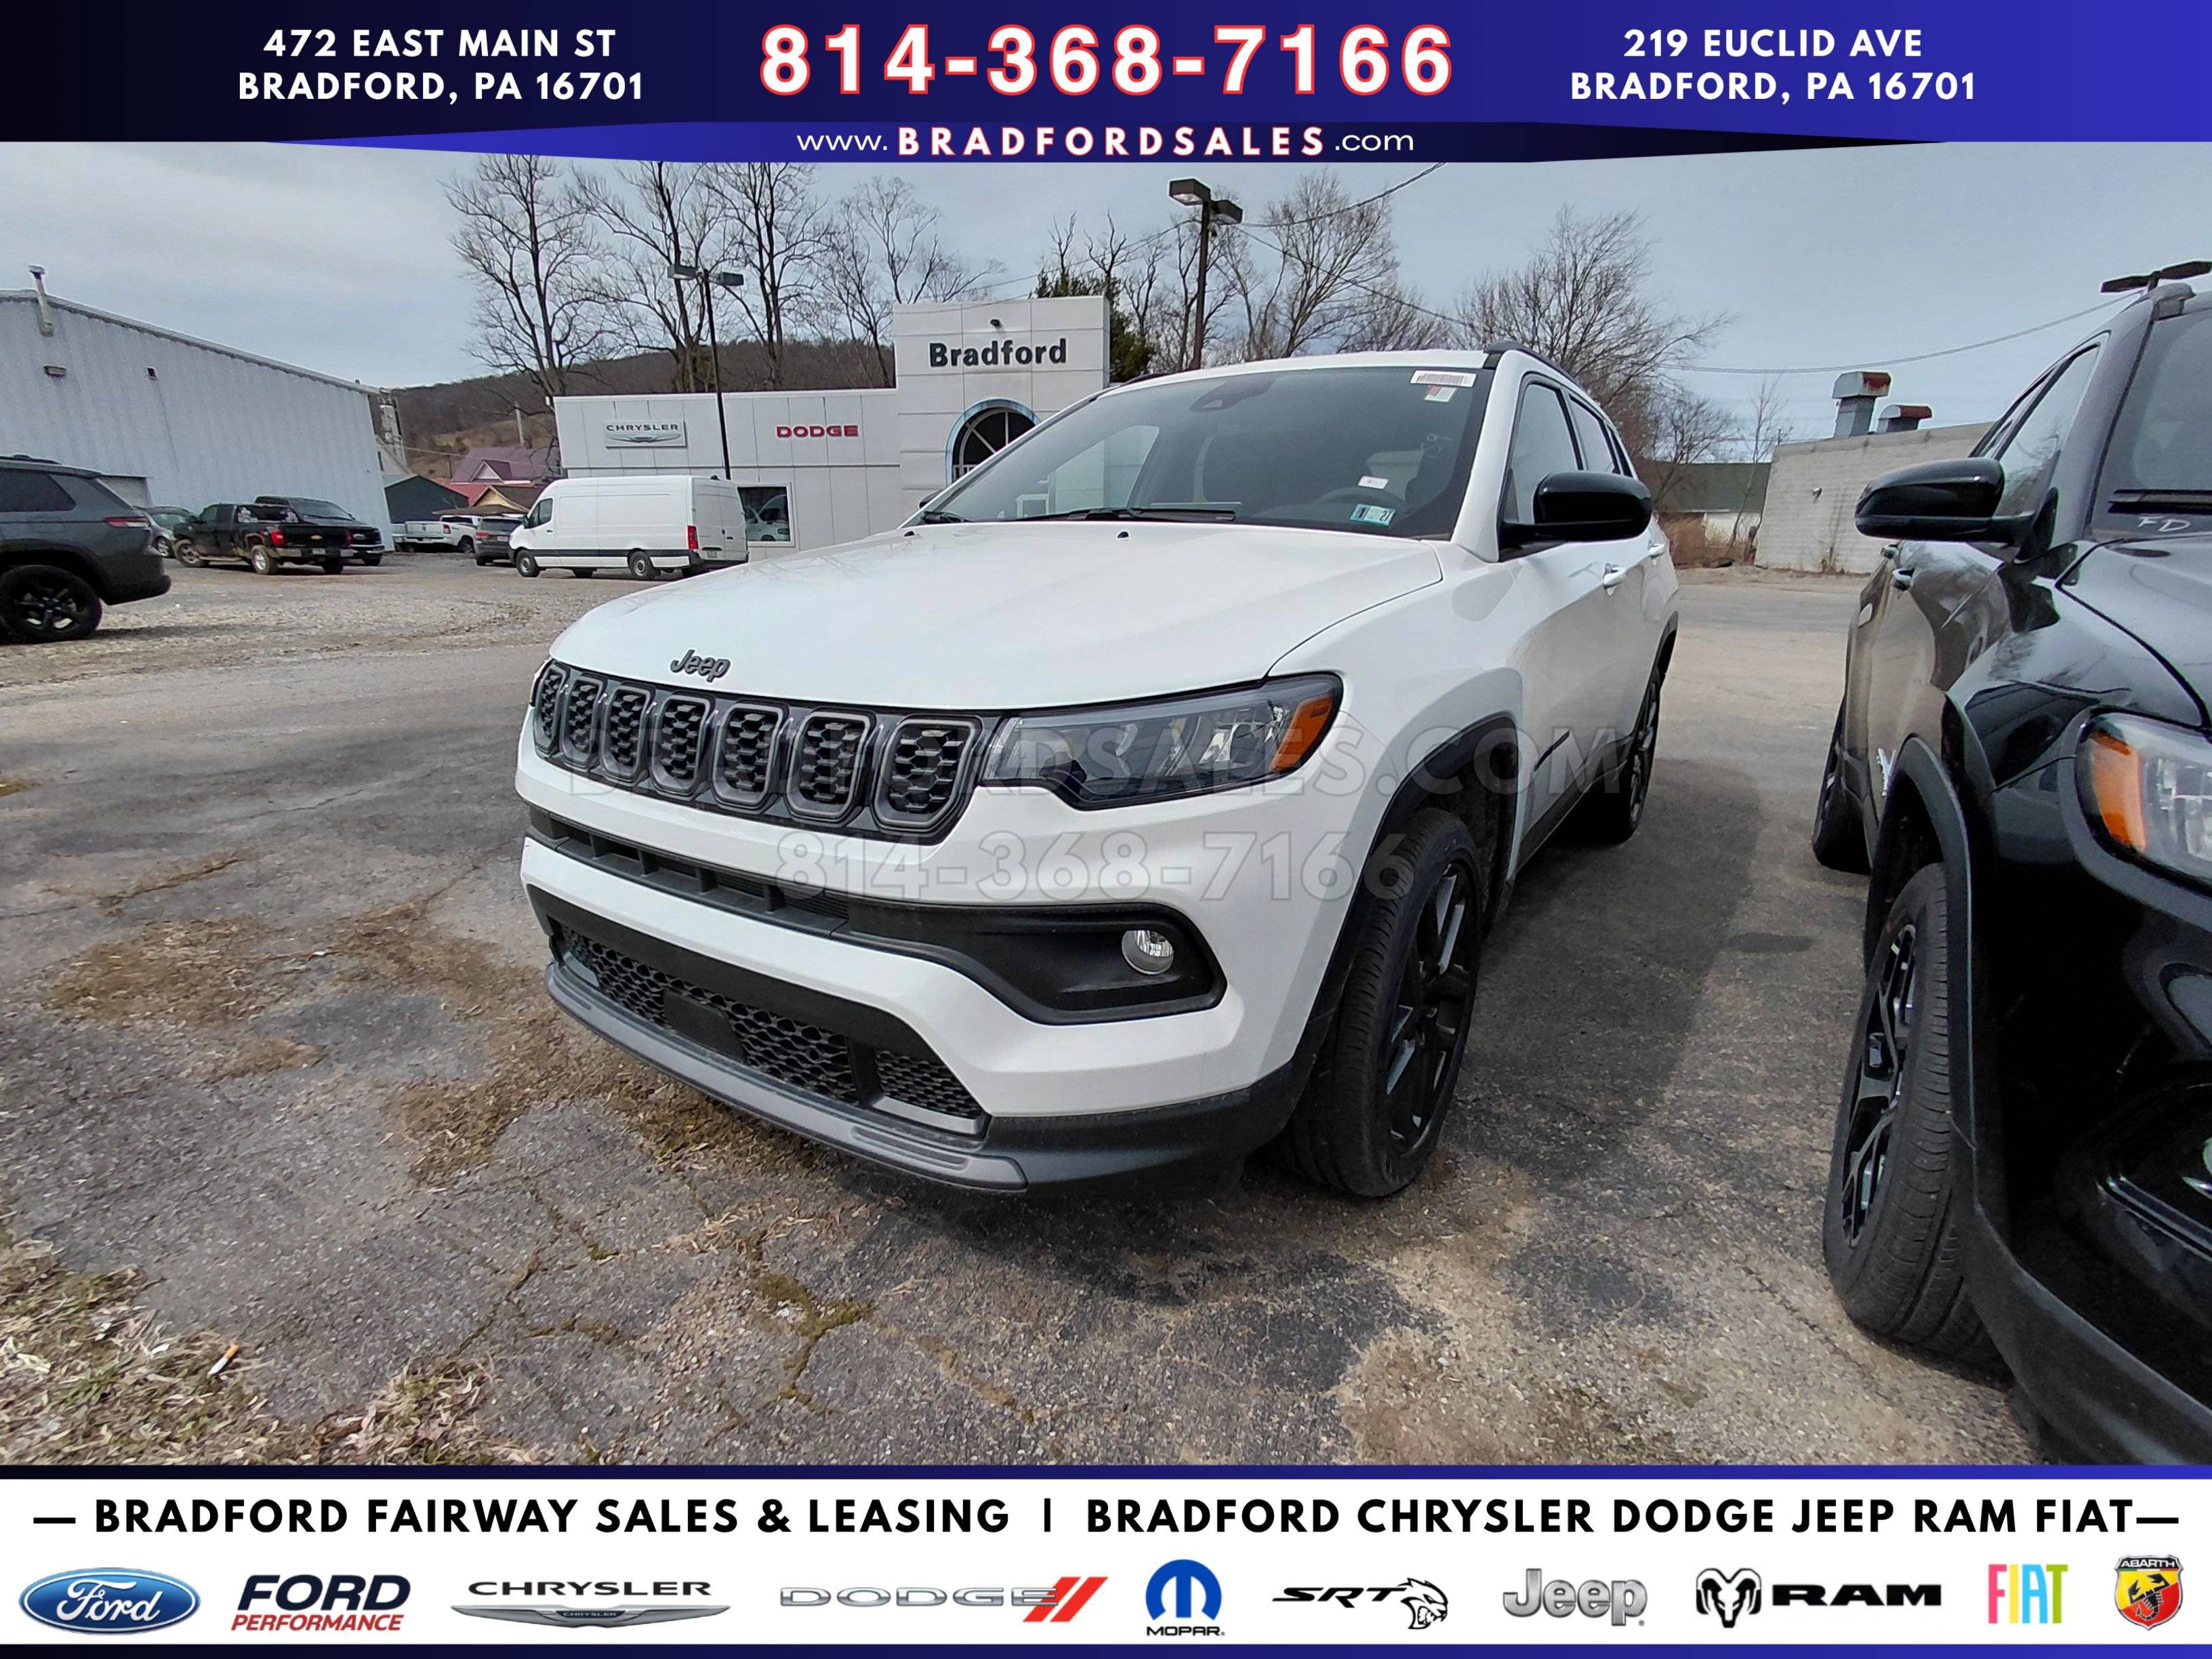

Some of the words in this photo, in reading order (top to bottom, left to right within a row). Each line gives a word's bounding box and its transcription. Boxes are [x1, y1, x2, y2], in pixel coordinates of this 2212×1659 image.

[929, 337, 1067, 367] Bradford
[776, 425, 859, 438] DODGE
[670, 649, 731, 683] Jeep
